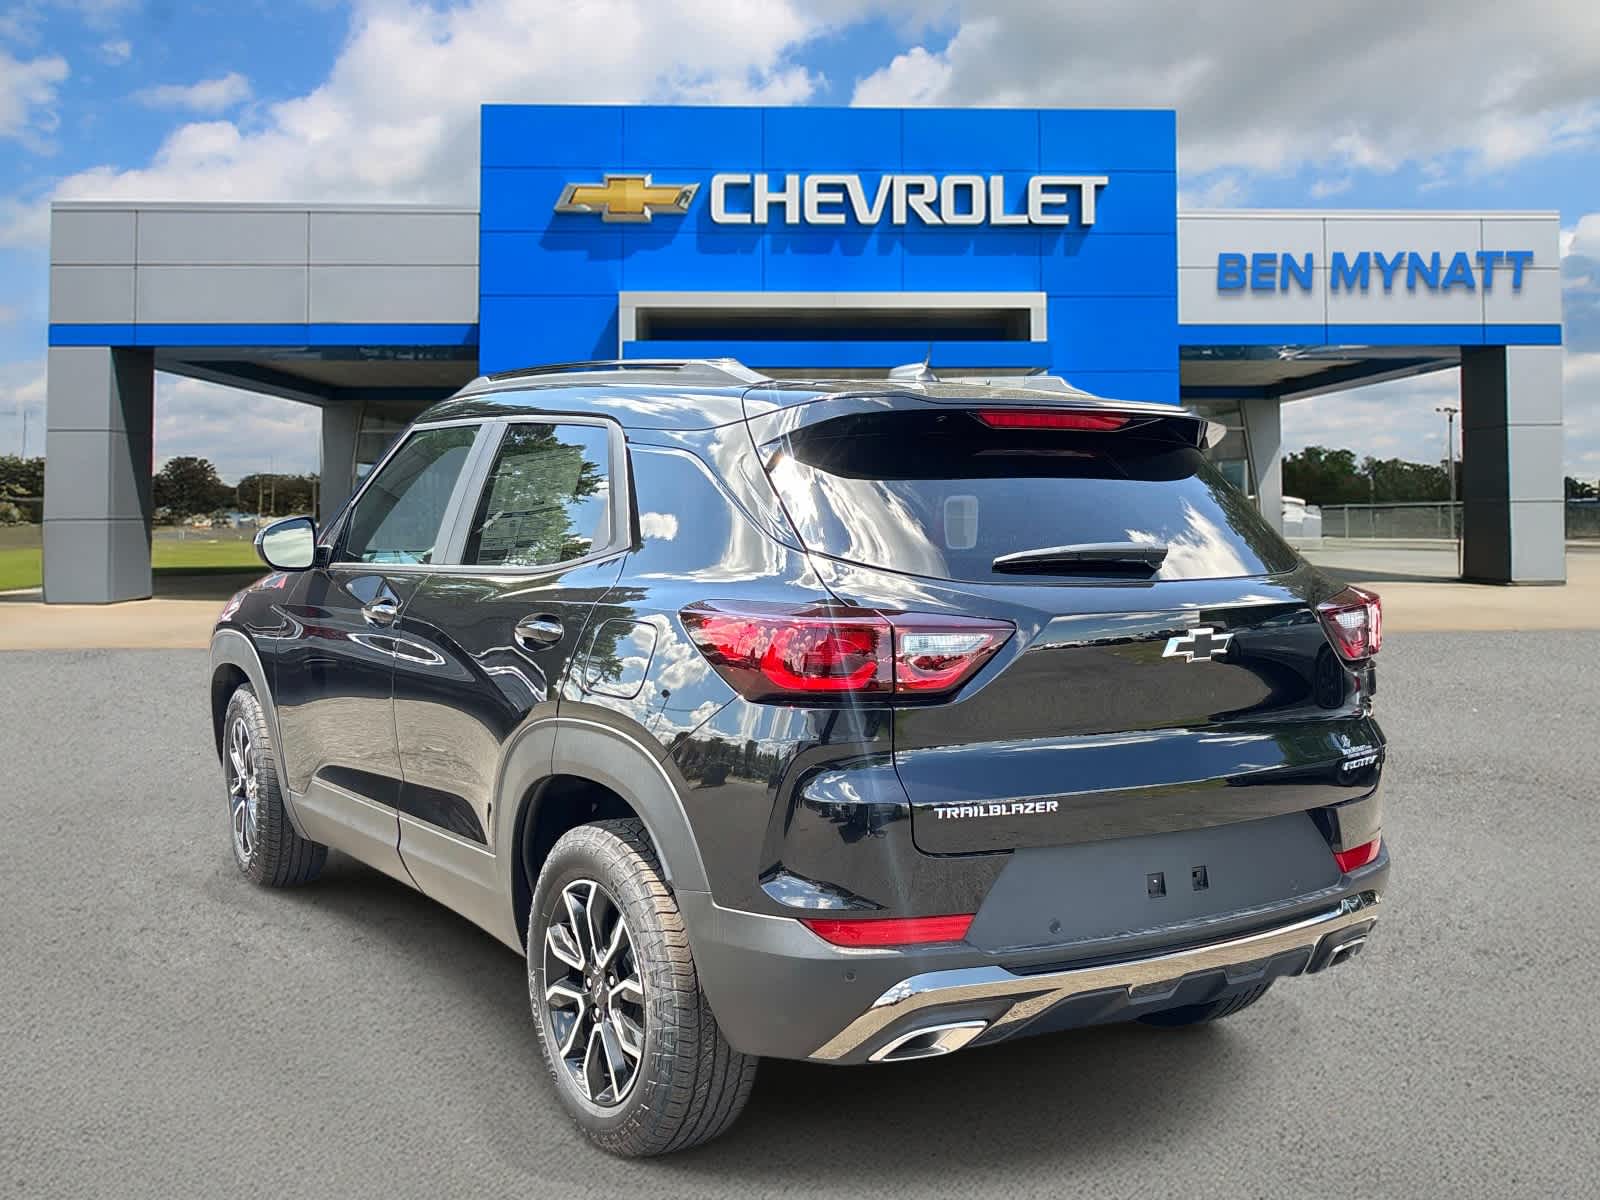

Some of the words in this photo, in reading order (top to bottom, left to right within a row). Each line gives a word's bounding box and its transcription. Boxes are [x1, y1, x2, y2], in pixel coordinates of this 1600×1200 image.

[710, 174, 1108, 225] CHEVROLET
[1217, 252, 1314, 291] BEN
[1330, 250, 1534, 290] MYNATT
[934, 801, 1059, 819] TRAILBLAZER
